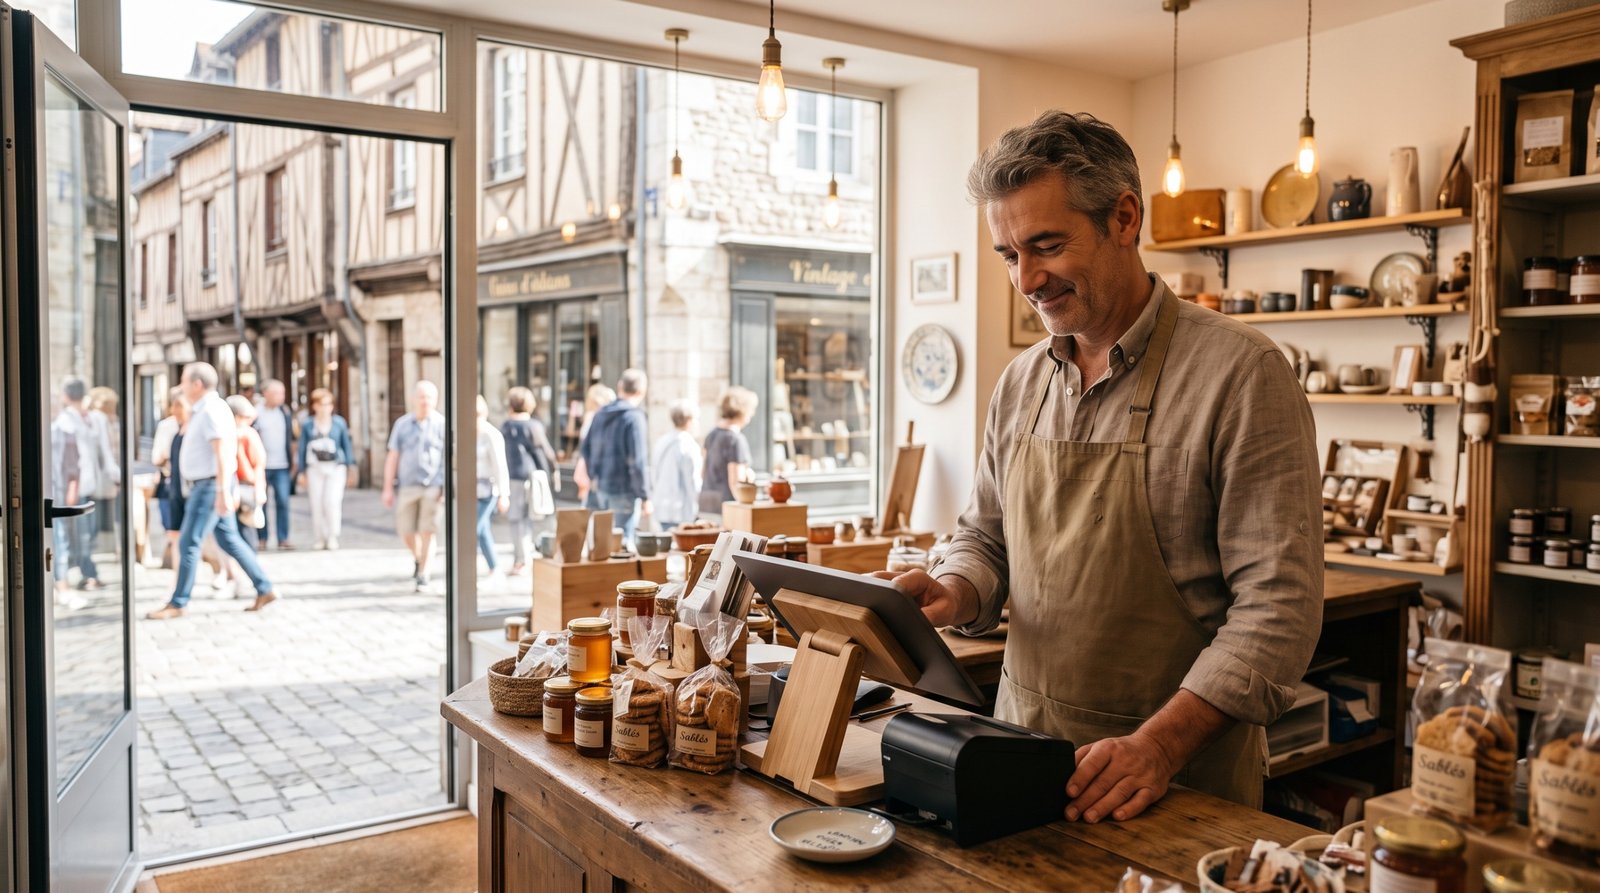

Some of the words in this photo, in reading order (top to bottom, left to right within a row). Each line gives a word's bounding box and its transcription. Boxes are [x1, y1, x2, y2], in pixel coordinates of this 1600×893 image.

[789, 260, 858, 295] Vintage
[615, 724, 640, 738] Sablés
[680, 731, 708, 744] Sablés
[1418, 754, 1466, 779] Sablés
[1538, 769, 1597, 796] Sablés
